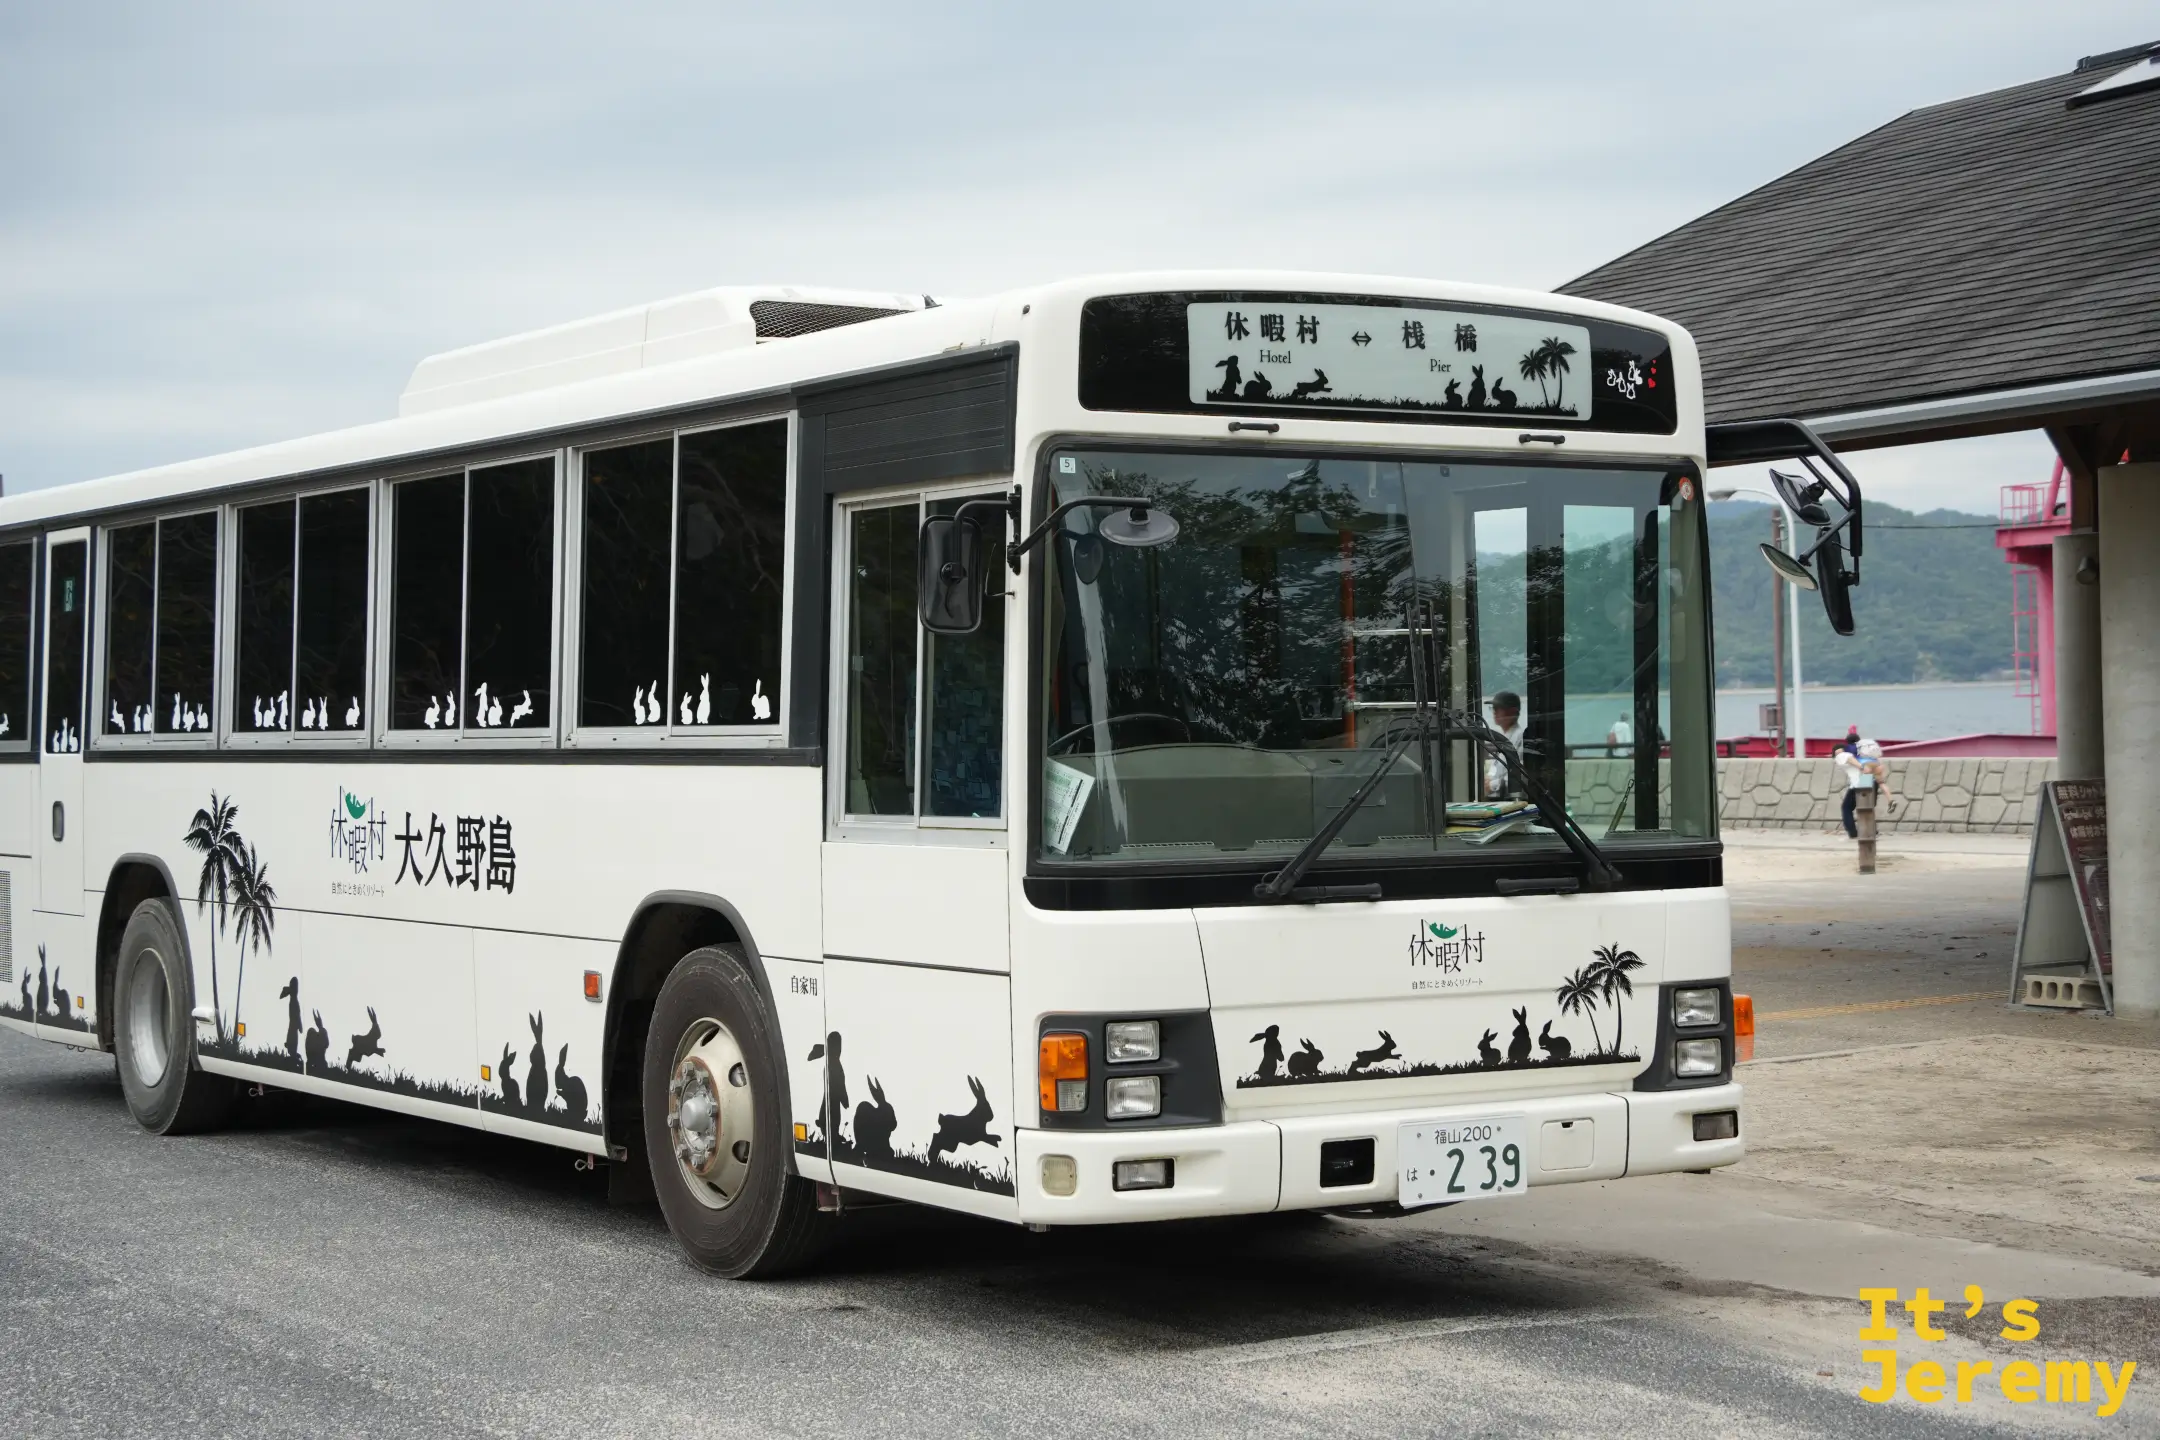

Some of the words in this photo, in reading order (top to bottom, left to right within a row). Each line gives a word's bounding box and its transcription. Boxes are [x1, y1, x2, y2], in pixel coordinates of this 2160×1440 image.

[1225, 311, 1320, 344] 休暇村
[1259, 349, 1292, 364] Hotel
[1429, 358, 1452, 372] Pier
[329, 785, 387, 874] 休暇村
[394, 811, 517, 895] 大久野島
[1408, 918, 1486, 974] 休暇村
[791, 975, 818, 997] 自家用
[1411, 977, 1484, 990] 自然にときめくリゾート
[1434, 1125, 1492, 1145] 福山200
